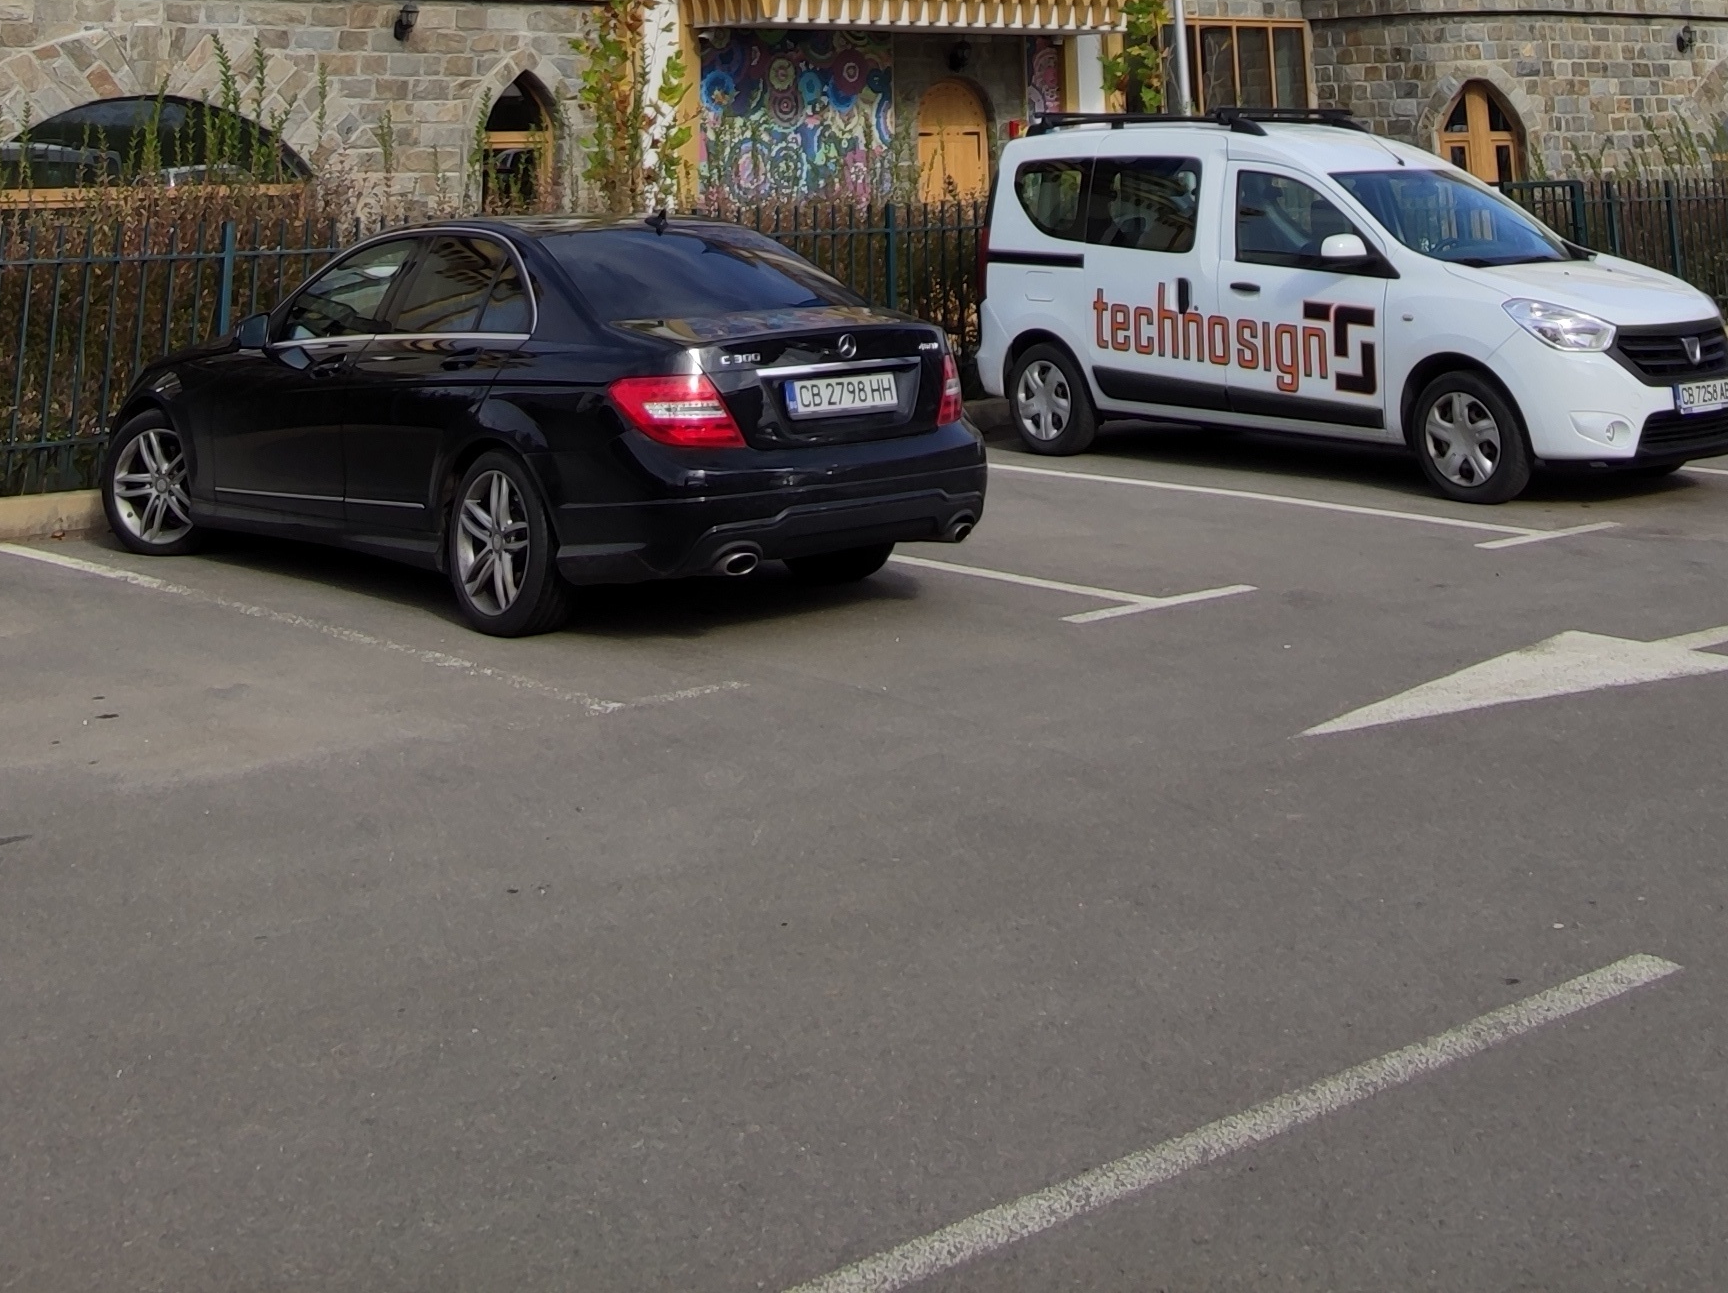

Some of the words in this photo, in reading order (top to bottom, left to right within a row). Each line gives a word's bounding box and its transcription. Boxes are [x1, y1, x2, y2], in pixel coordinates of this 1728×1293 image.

[1093, 281, 1329, 394] technosign
[721, 355, 731, 365] C
[733, 352, 761, 364] 300
[799, 383, 823, 408] CB
[825, 380, 868, 406] 2798
[870, 377, 894, 402] HH
[1682, 387, 1694, 405] CB
